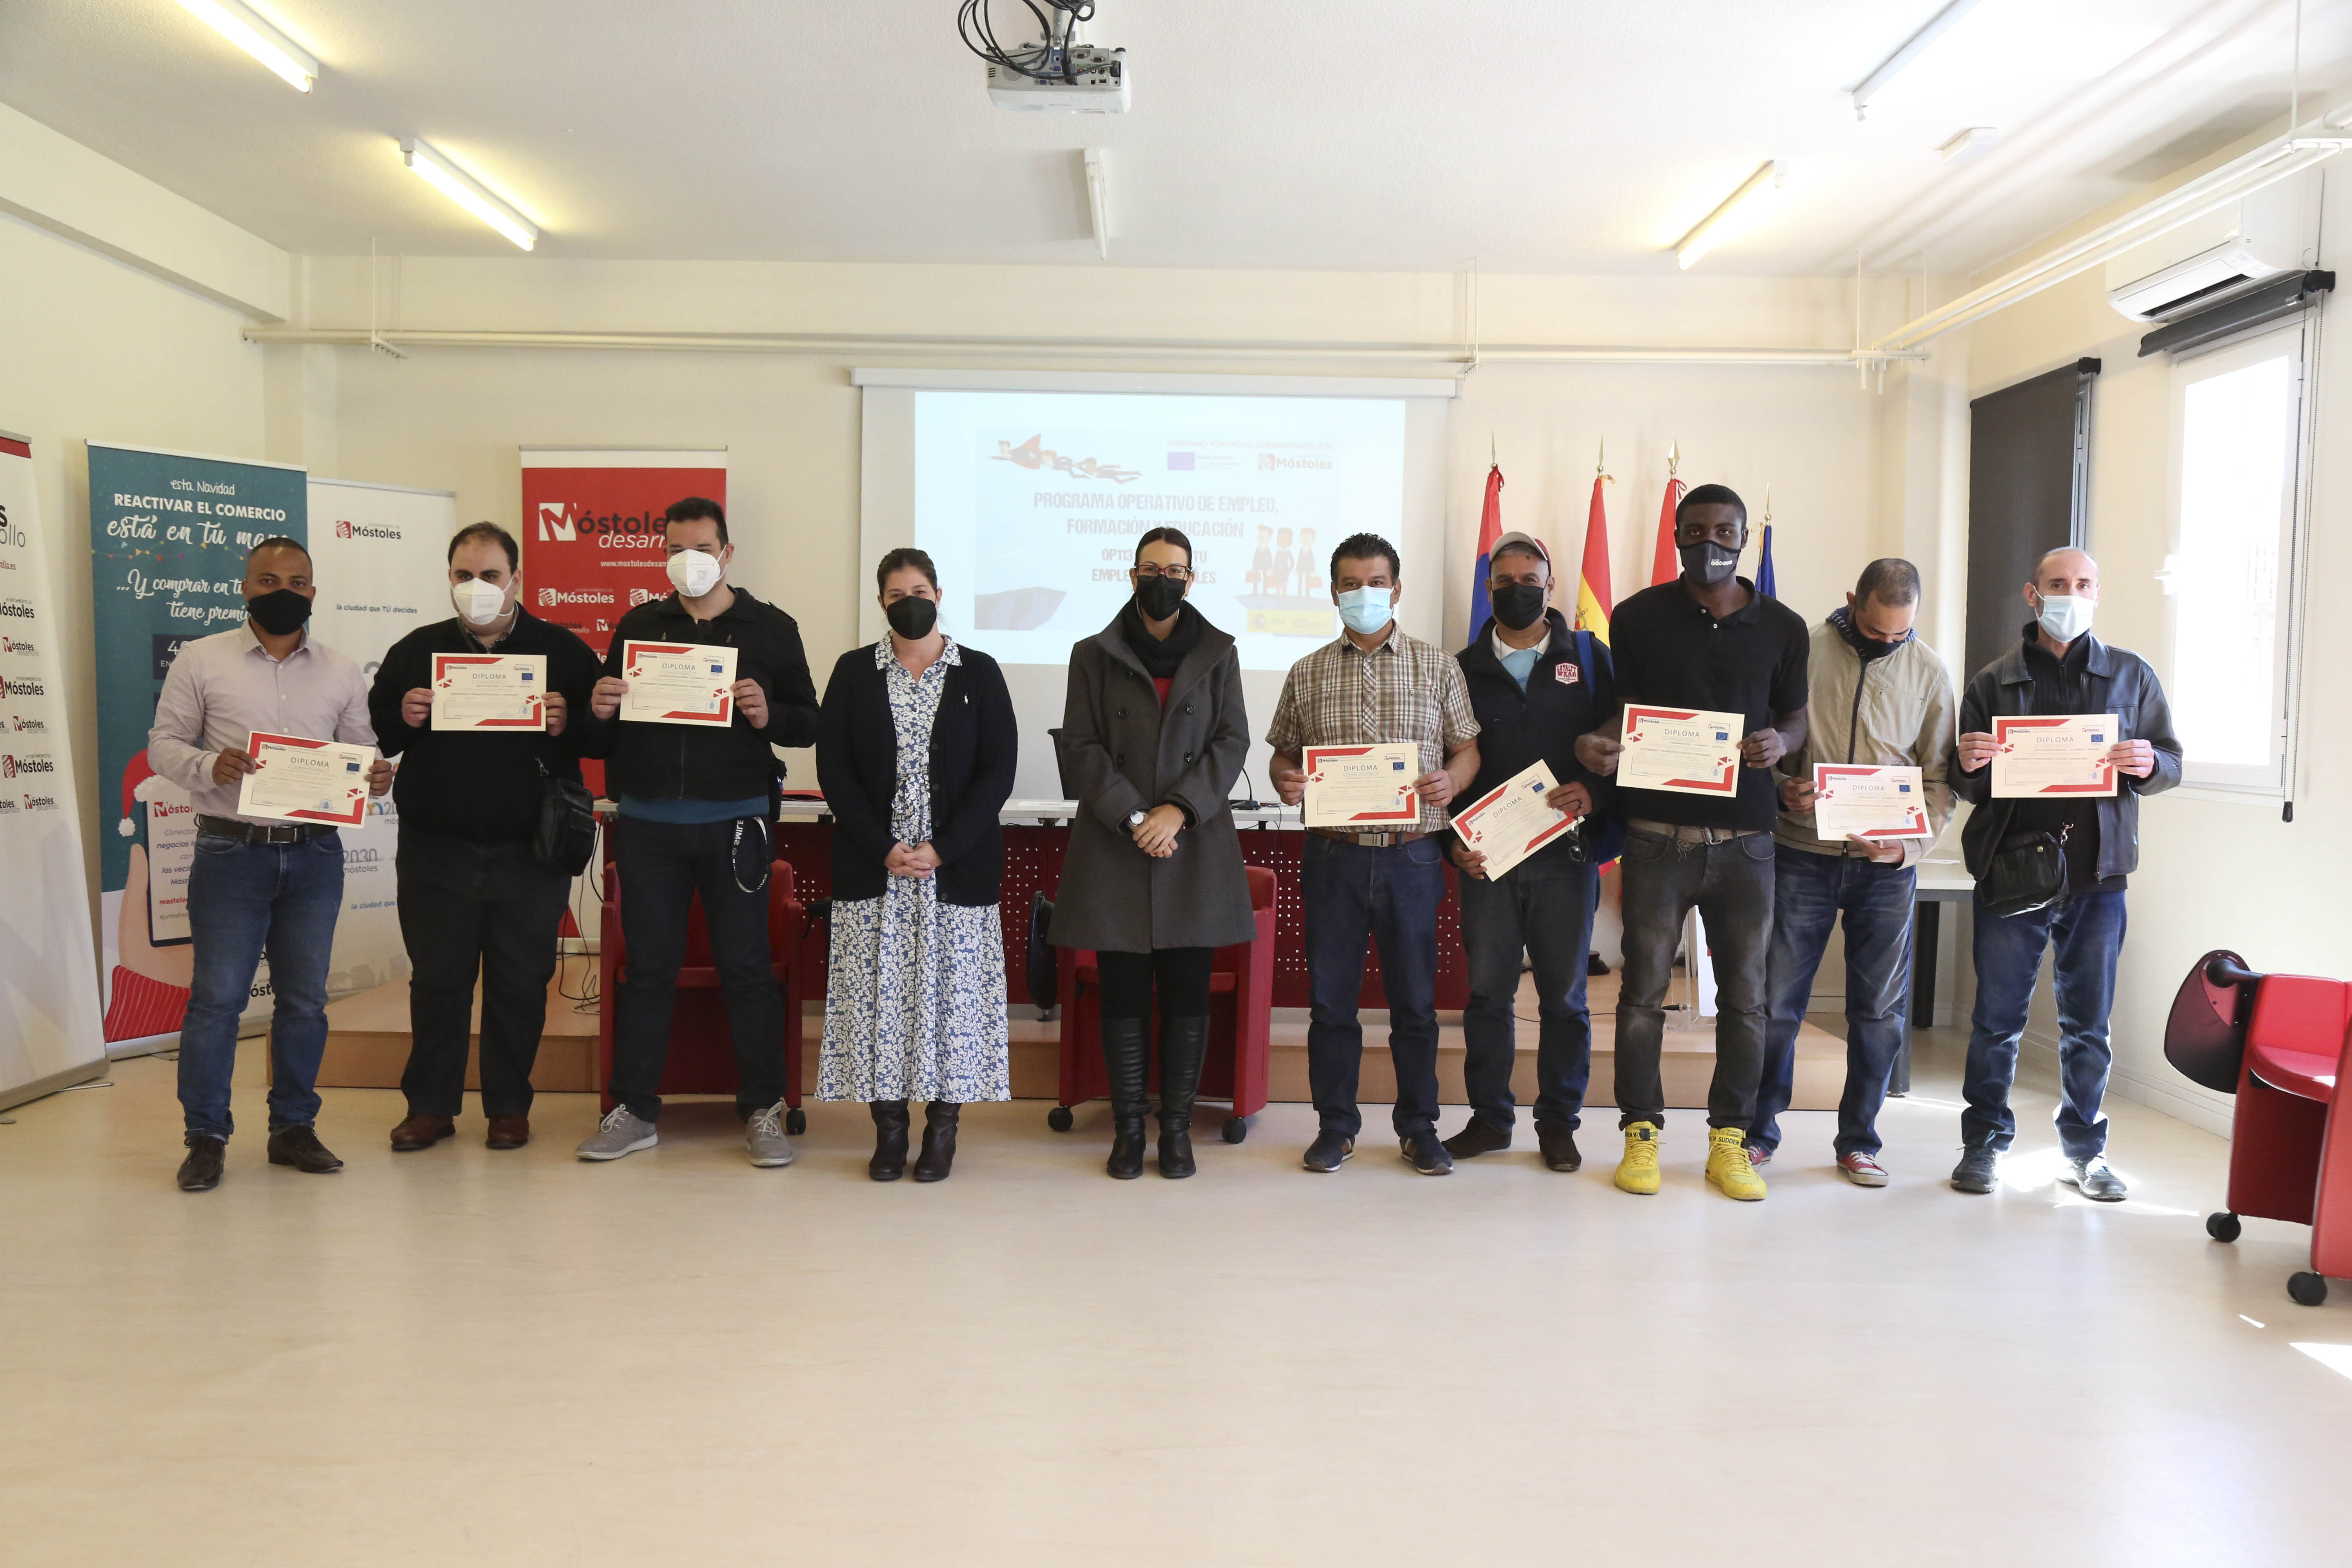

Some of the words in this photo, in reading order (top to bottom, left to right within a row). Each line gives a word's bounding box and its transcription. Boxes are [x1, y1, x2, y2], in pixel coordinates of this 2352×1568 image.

[1276, 457, 1332, 469] Móstoles
[170, 479, 194, 491] esta
[197, 481, 235, 496] Navidad
[114, 493, 193, 512] REACTIVAR
[197, 501, 212, 514] EL
[216, 503, 286, 521] COMERCIO
[1034, 492, 1114, 509] PROGRAMA
[1117, 494, 1195, 511] OPERATIVO
[1198, 496, 1215, 511] DE
[1218, 497, 1279, 514] EMPLEO,
[107, 514, 158, 539] está
[166, 526, 194, 545] en
[197, 521, 226, 545] tu
[352, 526, 402, 539] Móstoles
[1067, 516, 1147, 535] FORMACIÓN
[153, 578, 210, 598] comprar
[214, 582, 229, 595] en
[557, 591, 615, 604] Móstoles
[166, 601, 205, 619] tiene
[4, 681, 44, 695] Móstoles
[1664, 729, 1700, 737] DIPLOMA
[15, 759, 53, 773] Móstoles
[291, 757, 330, 768] DIPLOMA
[1493, 797, 1523, 818] DIPLOMA
[157, 841, 189, 849] negocios
[359, 900, 382, 909] ciudad
[1718, 1137, 1740, 1145] SUDDEN
